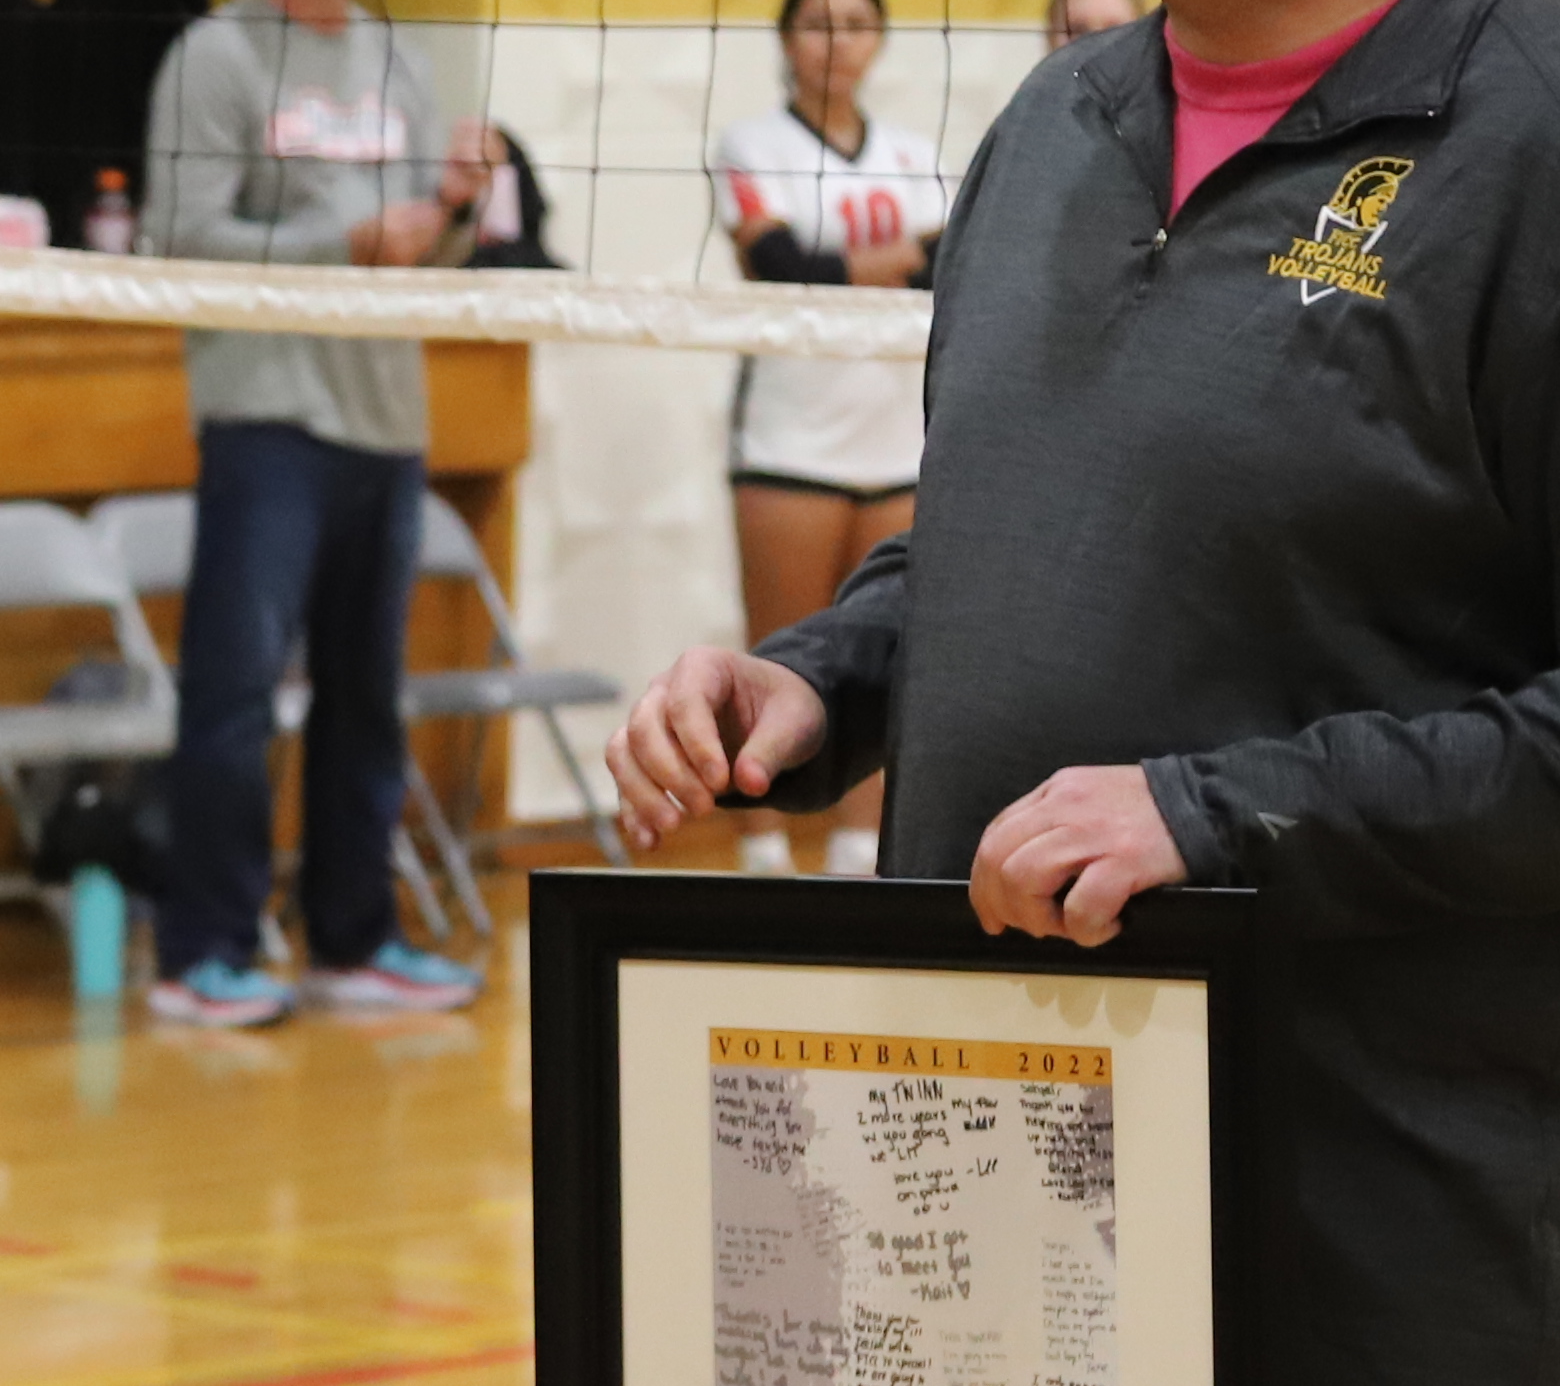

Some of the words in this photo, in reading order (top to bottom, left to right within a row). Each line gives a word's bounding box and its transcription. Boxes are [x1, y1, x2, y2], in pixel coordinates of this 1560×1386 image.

[840, 188, 903, 249] 10
[1267, 254, 1388, 299] VOLLEYBALL
[1288, 237, 1383, 275] TROJANS
[717, 1035, 970, 1069] VOLLEYBALL
[1018, 1052, 1105, 1077] 2022
